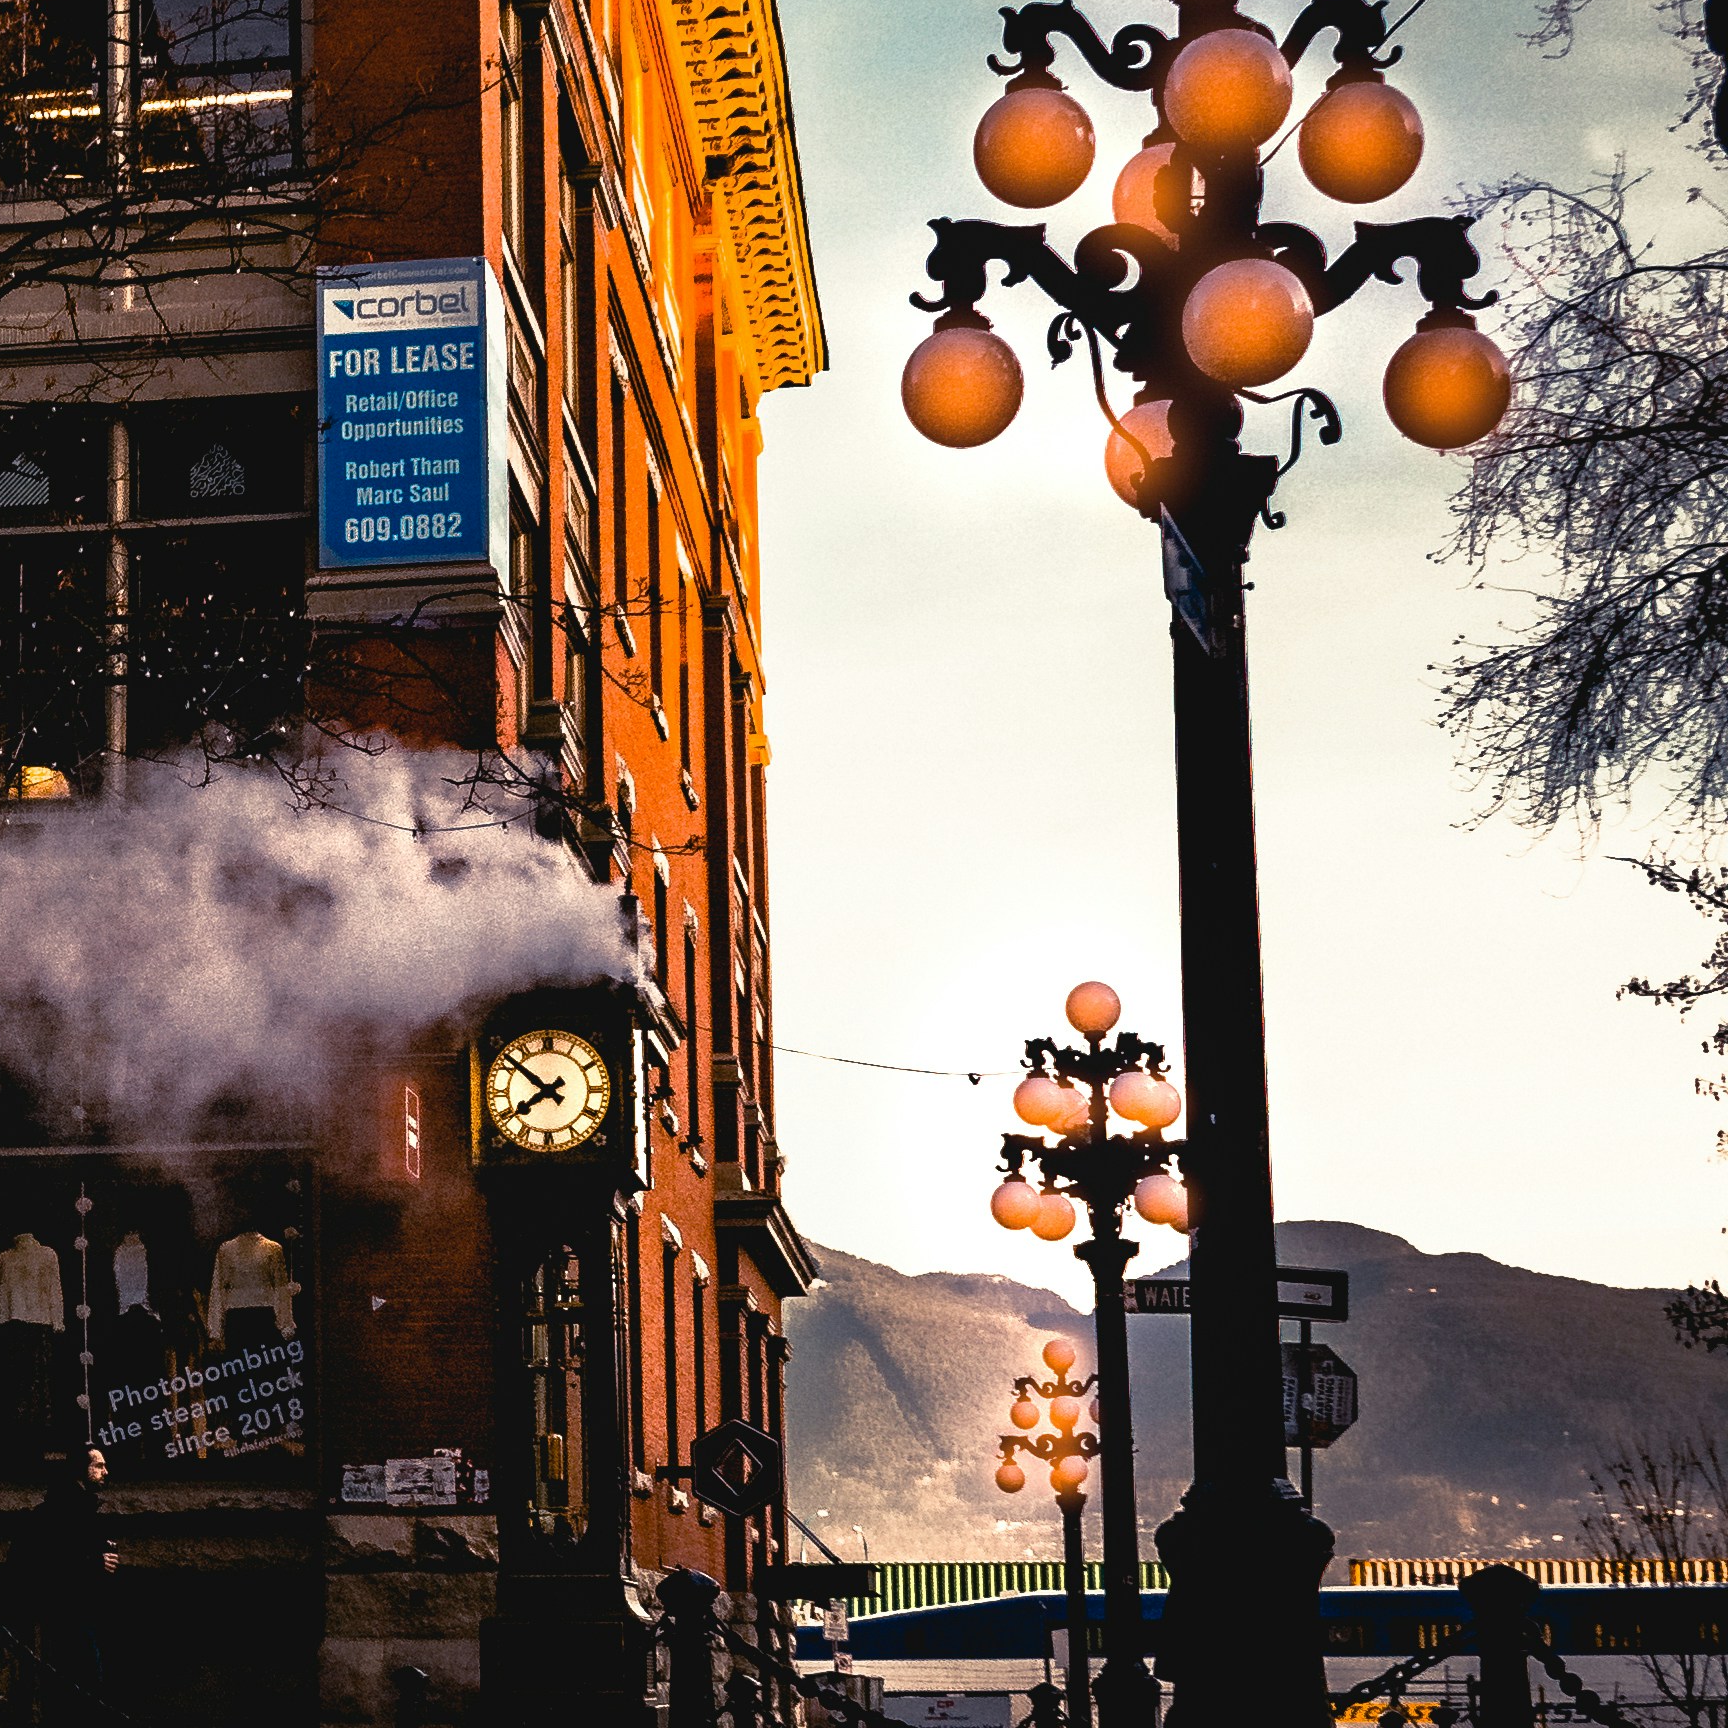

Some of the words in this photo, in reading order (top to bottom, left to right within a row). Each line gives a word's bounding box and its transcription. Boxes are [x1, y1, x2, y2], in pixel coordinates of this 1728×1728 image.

[357, 286, 469, 319] corbel
[329, 348, 380, 378] FOR
[390, 342, 474, 373] LEASE
[345, 389, 459, 413] Retail/Office
[341, 416, 464, 442] Opportunities
[345, 458, 405, 480] Robert
[410, 456, 460, 476] Tham
[356, 486, 403, 506] Marc
[409, 482, 449, 503] Saul
[345, 512, 462, 543] 609.0882
[1144, 1286, 1191, 1308] WATE
[108, 1340, 304, 1412] Photobombing
[98, 1421, 142, 1447] the
[150, 1394, 229, 1431] steam
[237, 1366, 304, 1404] clock
[164, 1426, 230, 1459] since
[238, 1397, 304, 1437] 2018
